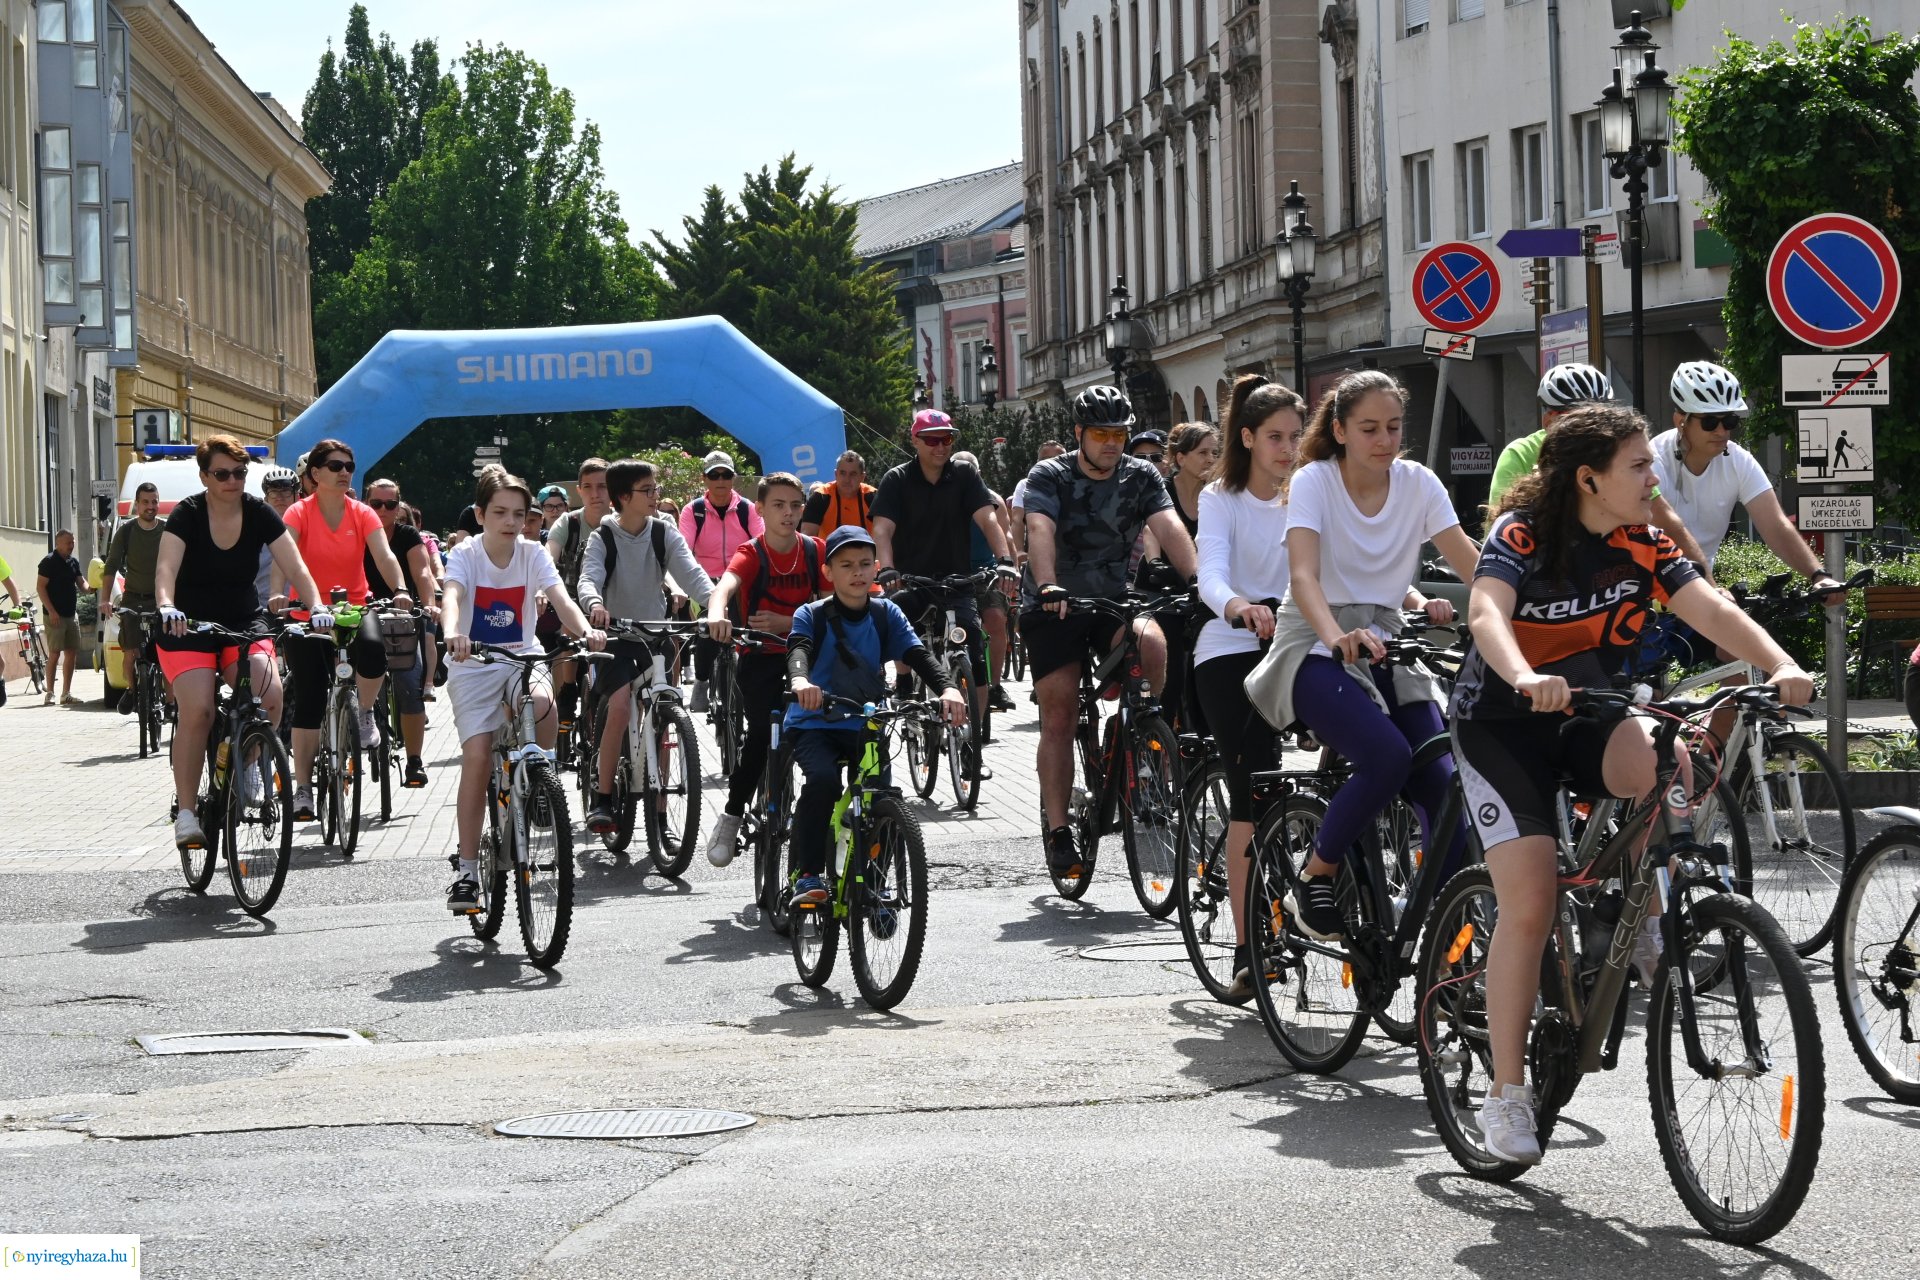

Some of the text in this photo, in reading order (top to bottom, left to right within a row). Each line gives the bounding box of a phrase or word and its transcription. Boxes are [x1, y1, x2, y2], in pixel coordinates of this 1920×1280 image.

[456, 348, 653, 384] SHIMANO
[1451, 450, 1490, 460] VIGYÁZZ
[1810, 498, 1862, 508] KIZÁRÓLAG
[1805, 518, 1868, 528] ENGEDÉLLYEL
